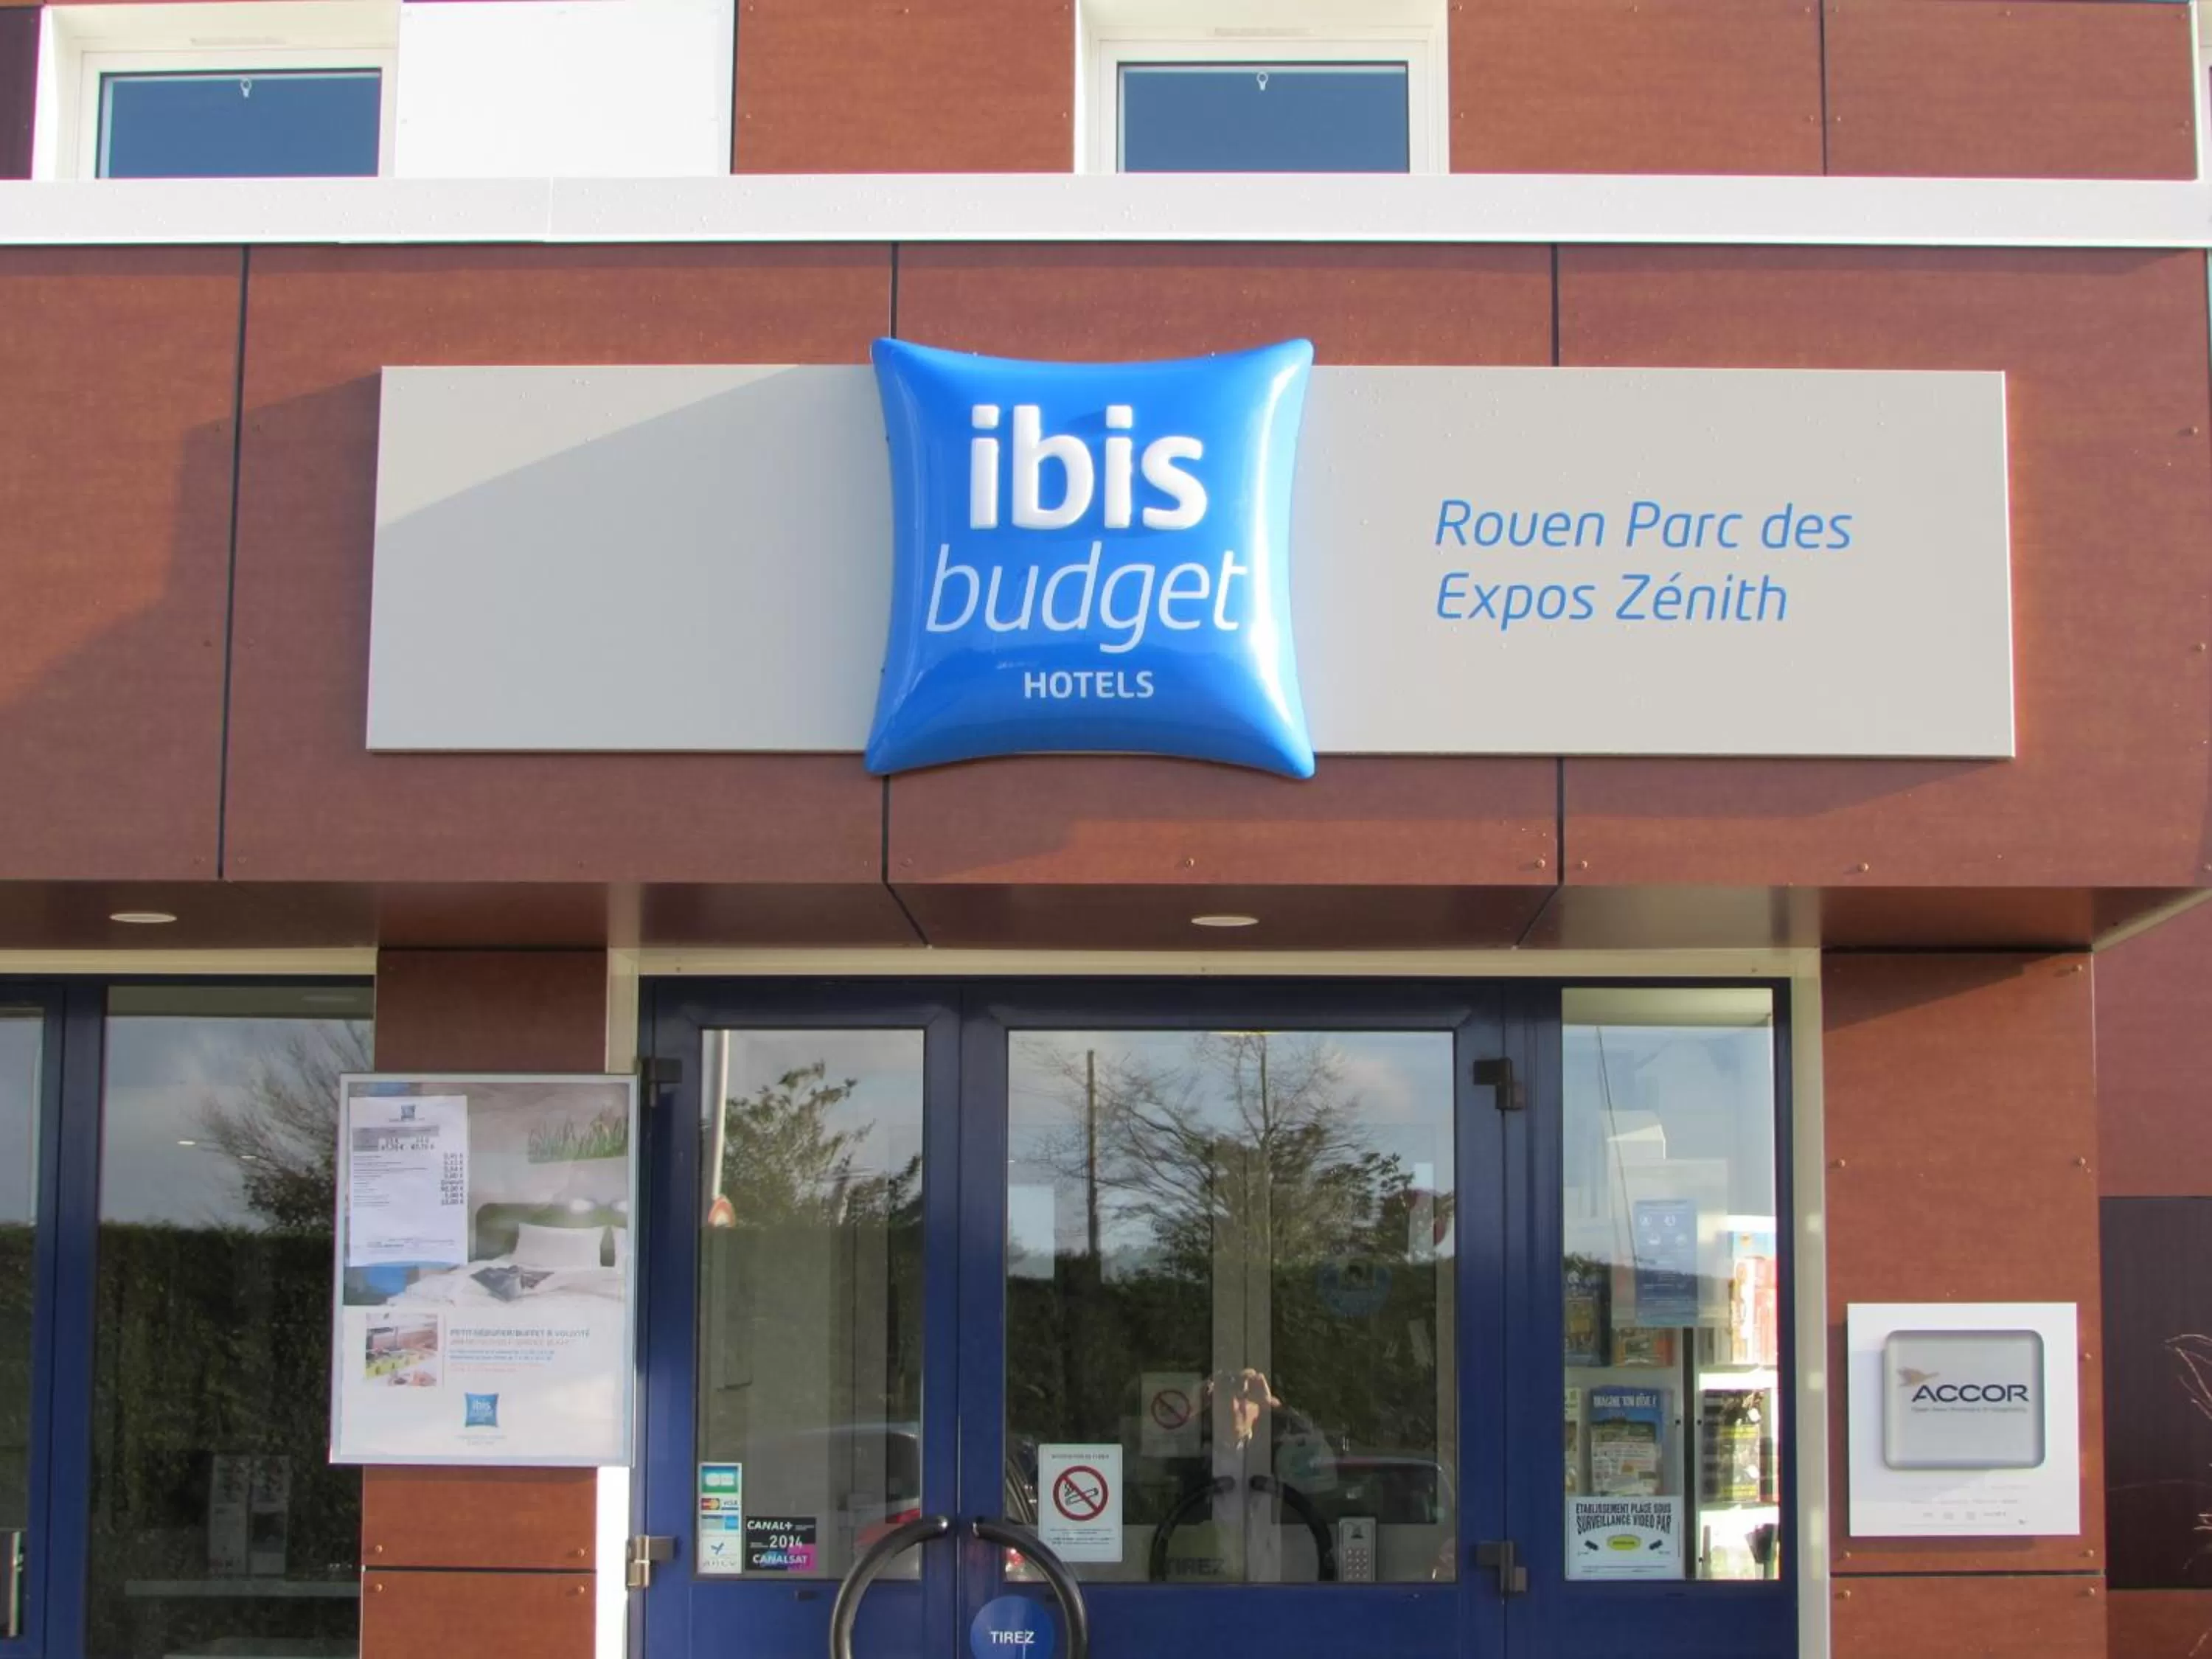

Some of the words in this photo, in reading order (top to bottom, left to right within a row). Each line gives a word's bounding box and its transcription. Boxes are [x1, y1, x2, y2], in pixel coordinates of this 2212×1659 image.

[970, 403, 1208, 530] ibis
[1434, 498, 1605, 548] Rouen
[1625, 501, 1744, 549] Parc
[1760, 501, 1854, 550] des
[925, 540, 1248, 653] budget
[1435, 571, 1596, 632] Expos
[1615, 571, 1789, 622] Zénith
[1023, 670, 1155, 699] HOTELS
[1911, 1384, 2029, 1402] ACCOR
[1576, 1502, 1629, 1514] ETABLISSEMENT
[1653, 1503, 1672, 1514] SOUS
[747, 1520, 793, 1531] CANAL+
[1576, 1514, 1632, 1534] SURVEILLANCE
[1655, 1514, 1672, 1534] PAR
[768, 1534, 803, 1548] 2014
[752, 1554, 809, 1565] CANALSAT
[990, 1630, 1035, 1644] TIREZ
